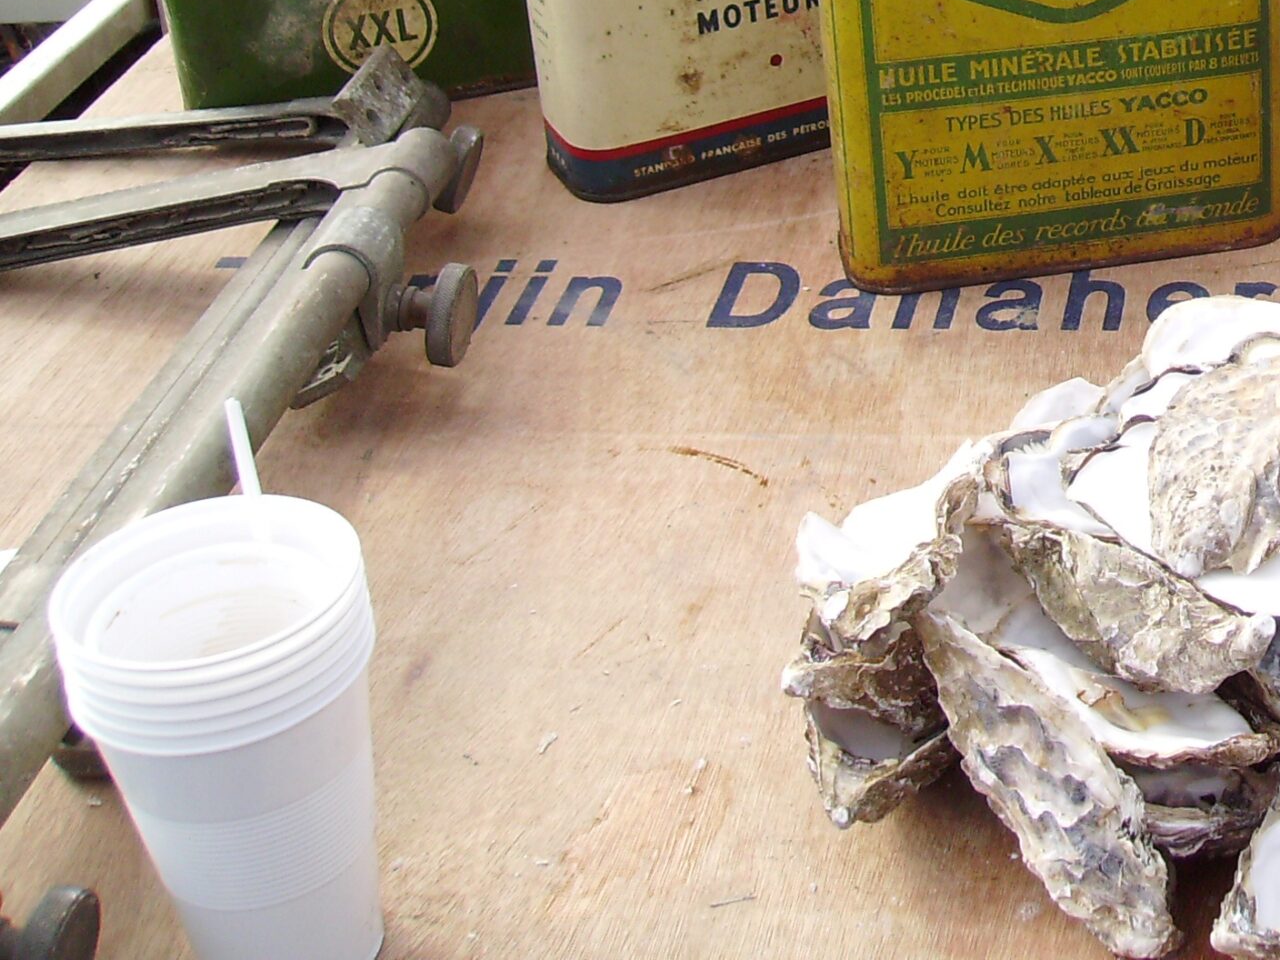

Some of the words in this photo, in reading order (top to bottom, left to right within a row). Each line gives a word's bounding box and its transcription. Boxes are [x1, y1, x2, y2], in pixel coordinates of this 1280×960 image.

[345, 8, 418, 51] XXL
[879, 62, 957, 90] HUILE
[969, 46, 1106, 81] MINÉRALE
[1117, 27, 1258, 65] STABILISÉE
[1065, 68, 1117, 87] YACCO
[1208, 56, 1218, 70] 8
[945, 112, 1002, 133] TYPES
[1007, 107, 1044, 126] DES
[1049, 99, 1112, 122] HUILES
[1118, 87, 1208, 113] YACCO
[767, 130, 788, 144] DES
[1098, 125, 1140, 157] XX
[1183, 118, 1206, 147] D
[895, 149, 919, 180] Y
[960, 142, 992, 174] M
[1033, 135, 1060, 165] X
[935, 198, 1011, 218] Consultez
[1018, 192, 1057, 208] notre
[1064, 187, 1121, 203] tableau
[1124, 183, 1142, 196] de
[1145, 173, 1221, 193] Graissage
[957, 187, 988, 200] doit
[1031, 173, 1096, 191] adaptée
[1102, 169, 1134, 183] aux
[1138, 164, 1176, 181] jeux
[1179, 159, 1199, 172] du
[982, 223, 1024, 248] des
[1033, 207, 1132, 240] records
